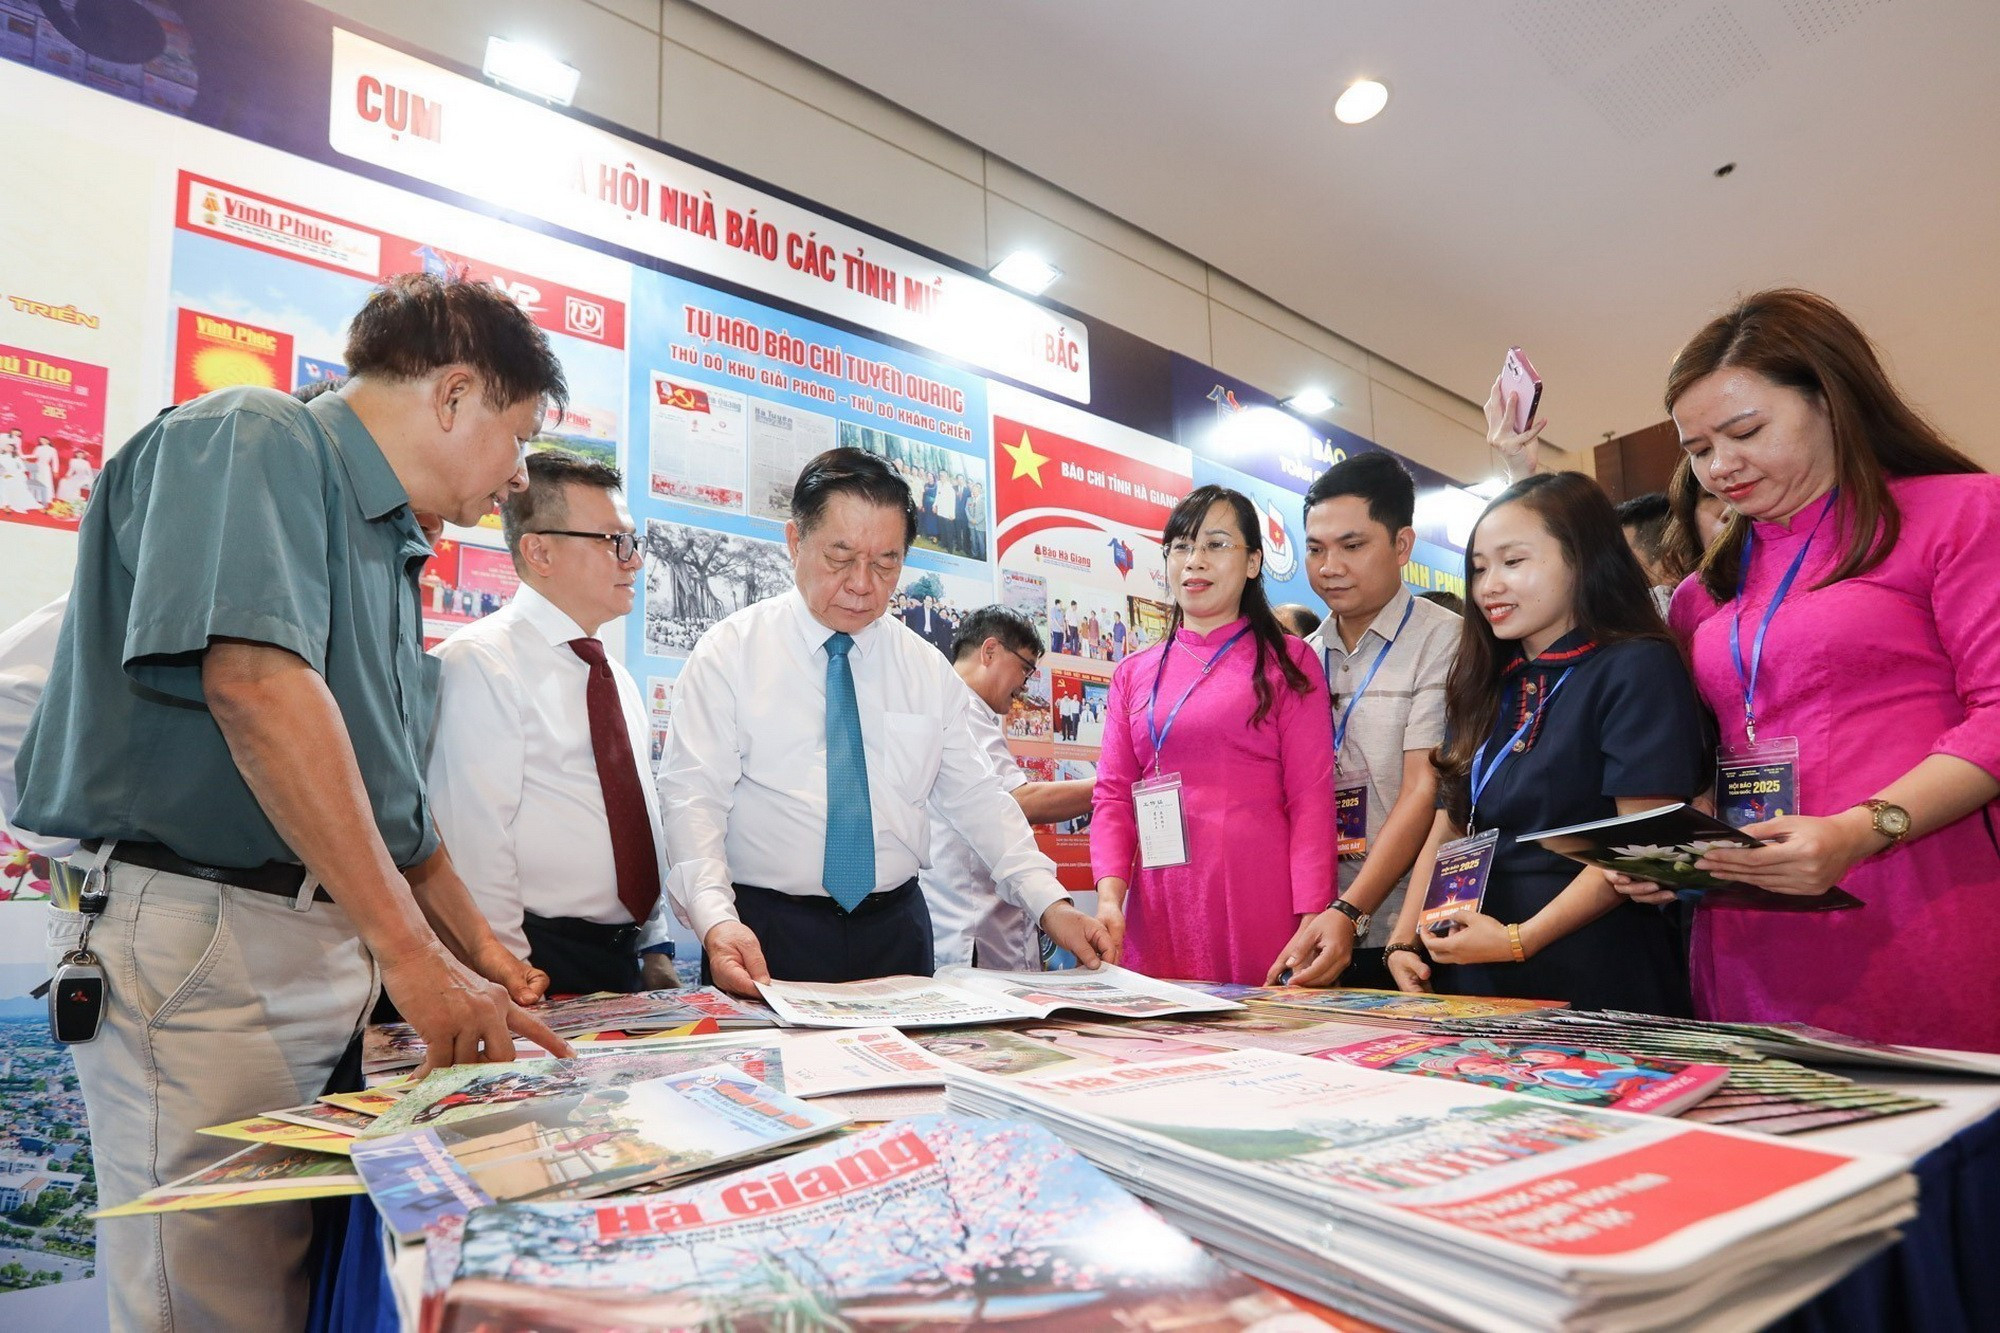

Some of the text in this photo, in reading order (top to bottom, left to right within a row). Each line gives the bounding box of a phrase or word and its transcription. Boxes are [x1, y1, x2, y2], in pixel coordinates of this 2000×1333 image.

[357, 74, 442, 144] CỤM
[599, 162, 650, 220] HỘI
[660, 184, 717, 241] NHÀ
[725, 208, 778, 262] BÁO
[786, 231, 836, 283] CÁC
[842, 247, 897, 305] TỈNH
[1045, 326, 1080, 373] BẮC
[670, 344, 698, 365] THỦ
[703, 353, 722, 371] ĐÔ
[728, 360, 756, 380] KHU
[760, 370, 788, 389] GIẢI
[792, 379, 835, 403] PHÓNG
[850, 394, 874, 413] THỦ
[877, 402, 894, 419] ĐÔ
[897, 409, 936, 431] KHÁNG
[939, 419, 972, 442] CHIẾN
[764, 329, 805, 366] BÁO
[809, 344, 842, 377] CHÍ
[845, 354, 903, 395] TUYÊN
[906, 374, 964, 413] QUANG
[1060, 461, 1179, 509] BÁO CHÍ TỈNH HÀ GIANG
[1070, 553, 1091, 567] Giang
[1341, 797, 1359, 808] 2025
[1740, 781, 1752, 789] BÁO
[1752, 780, 1780, 794] 2025
[1459, 858, 1480, 872] 2025
[720, 1130, 940, 1218] Giang
